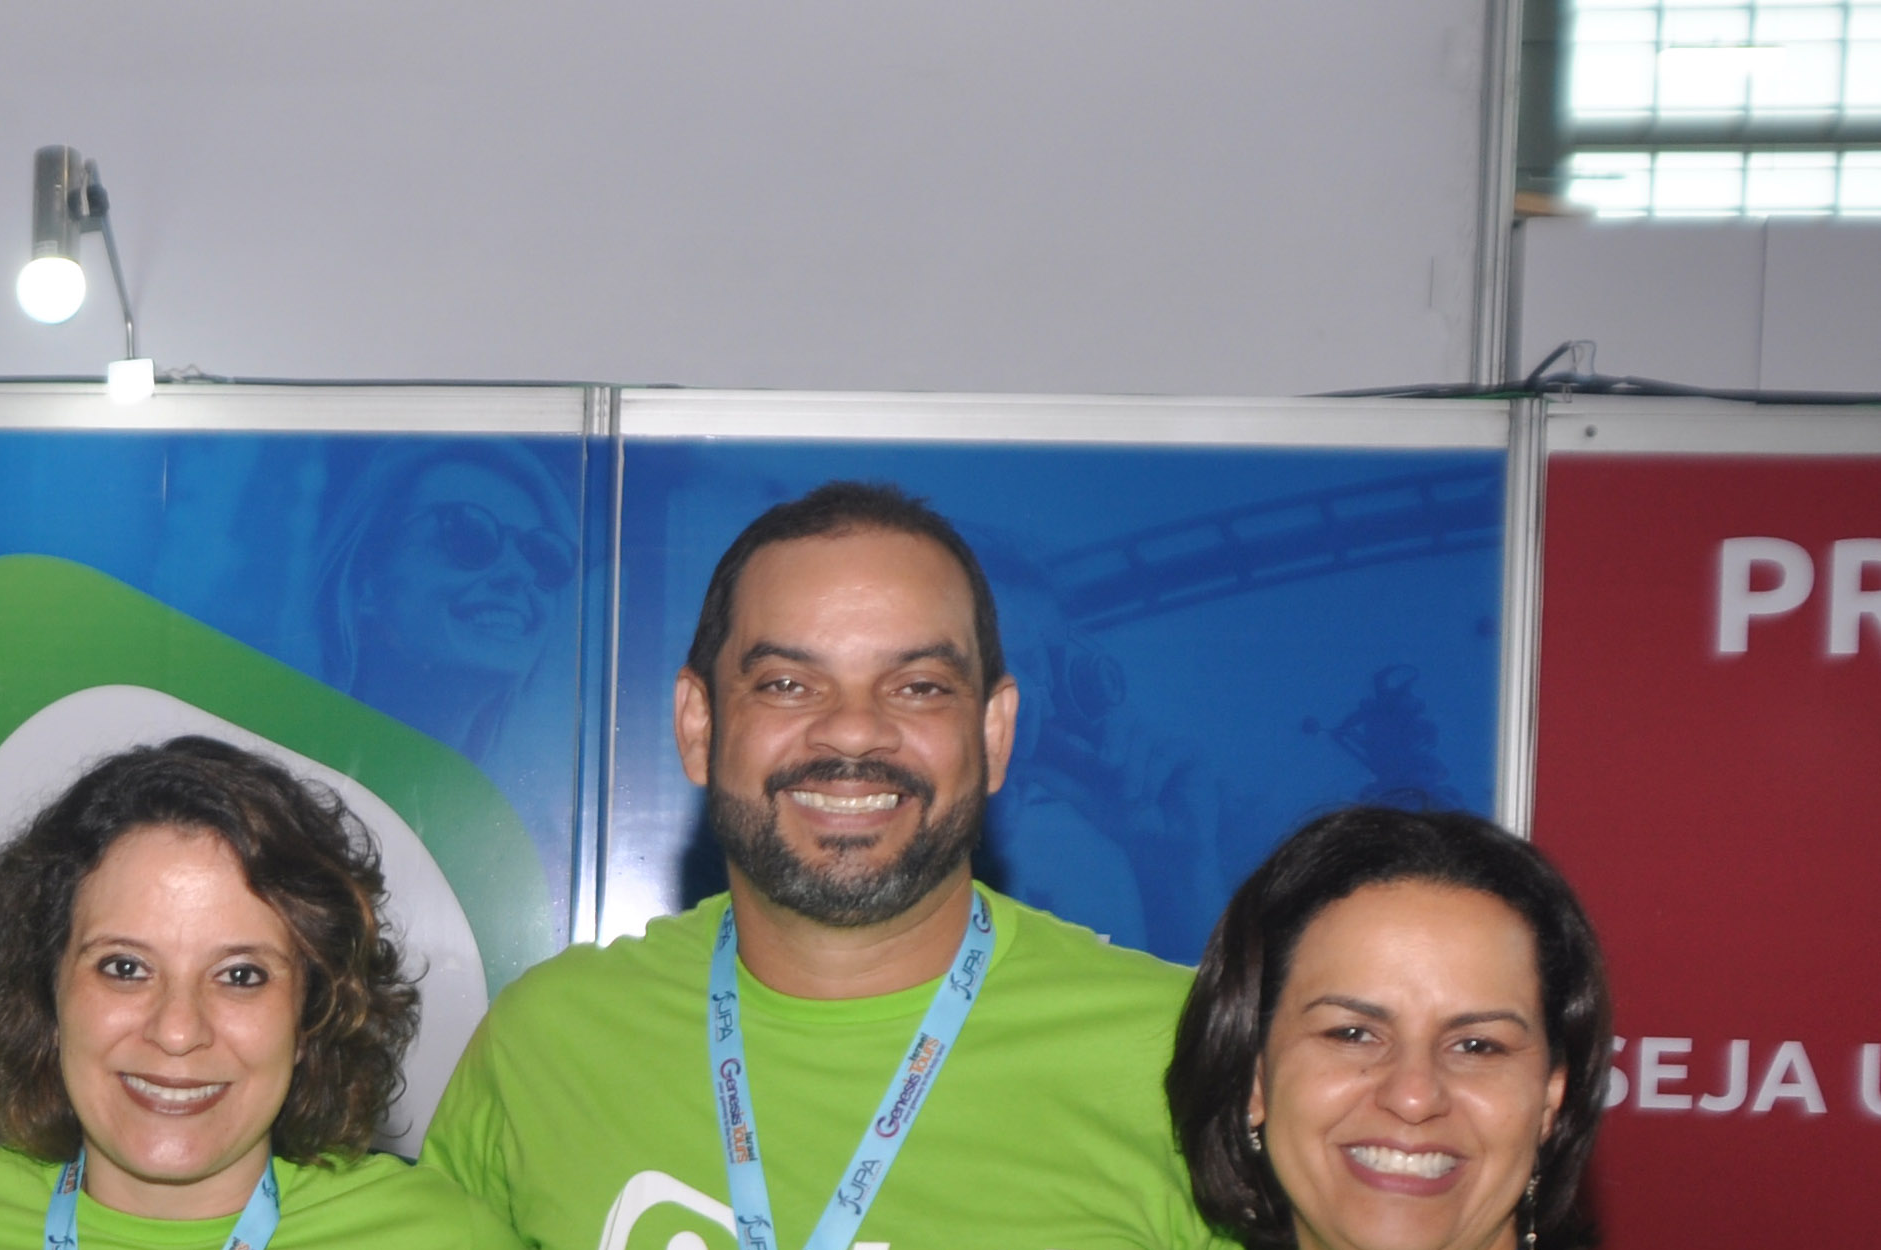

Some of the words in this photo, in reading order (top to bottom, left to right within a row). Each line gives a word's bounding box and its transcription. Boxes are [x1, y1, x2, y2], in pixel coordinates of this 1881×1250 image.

[720, 1057, 742, 1126] Genesis
[875, 1073, 922, 1138] Genesis
[908, 1035, 941, 1074] Tours
